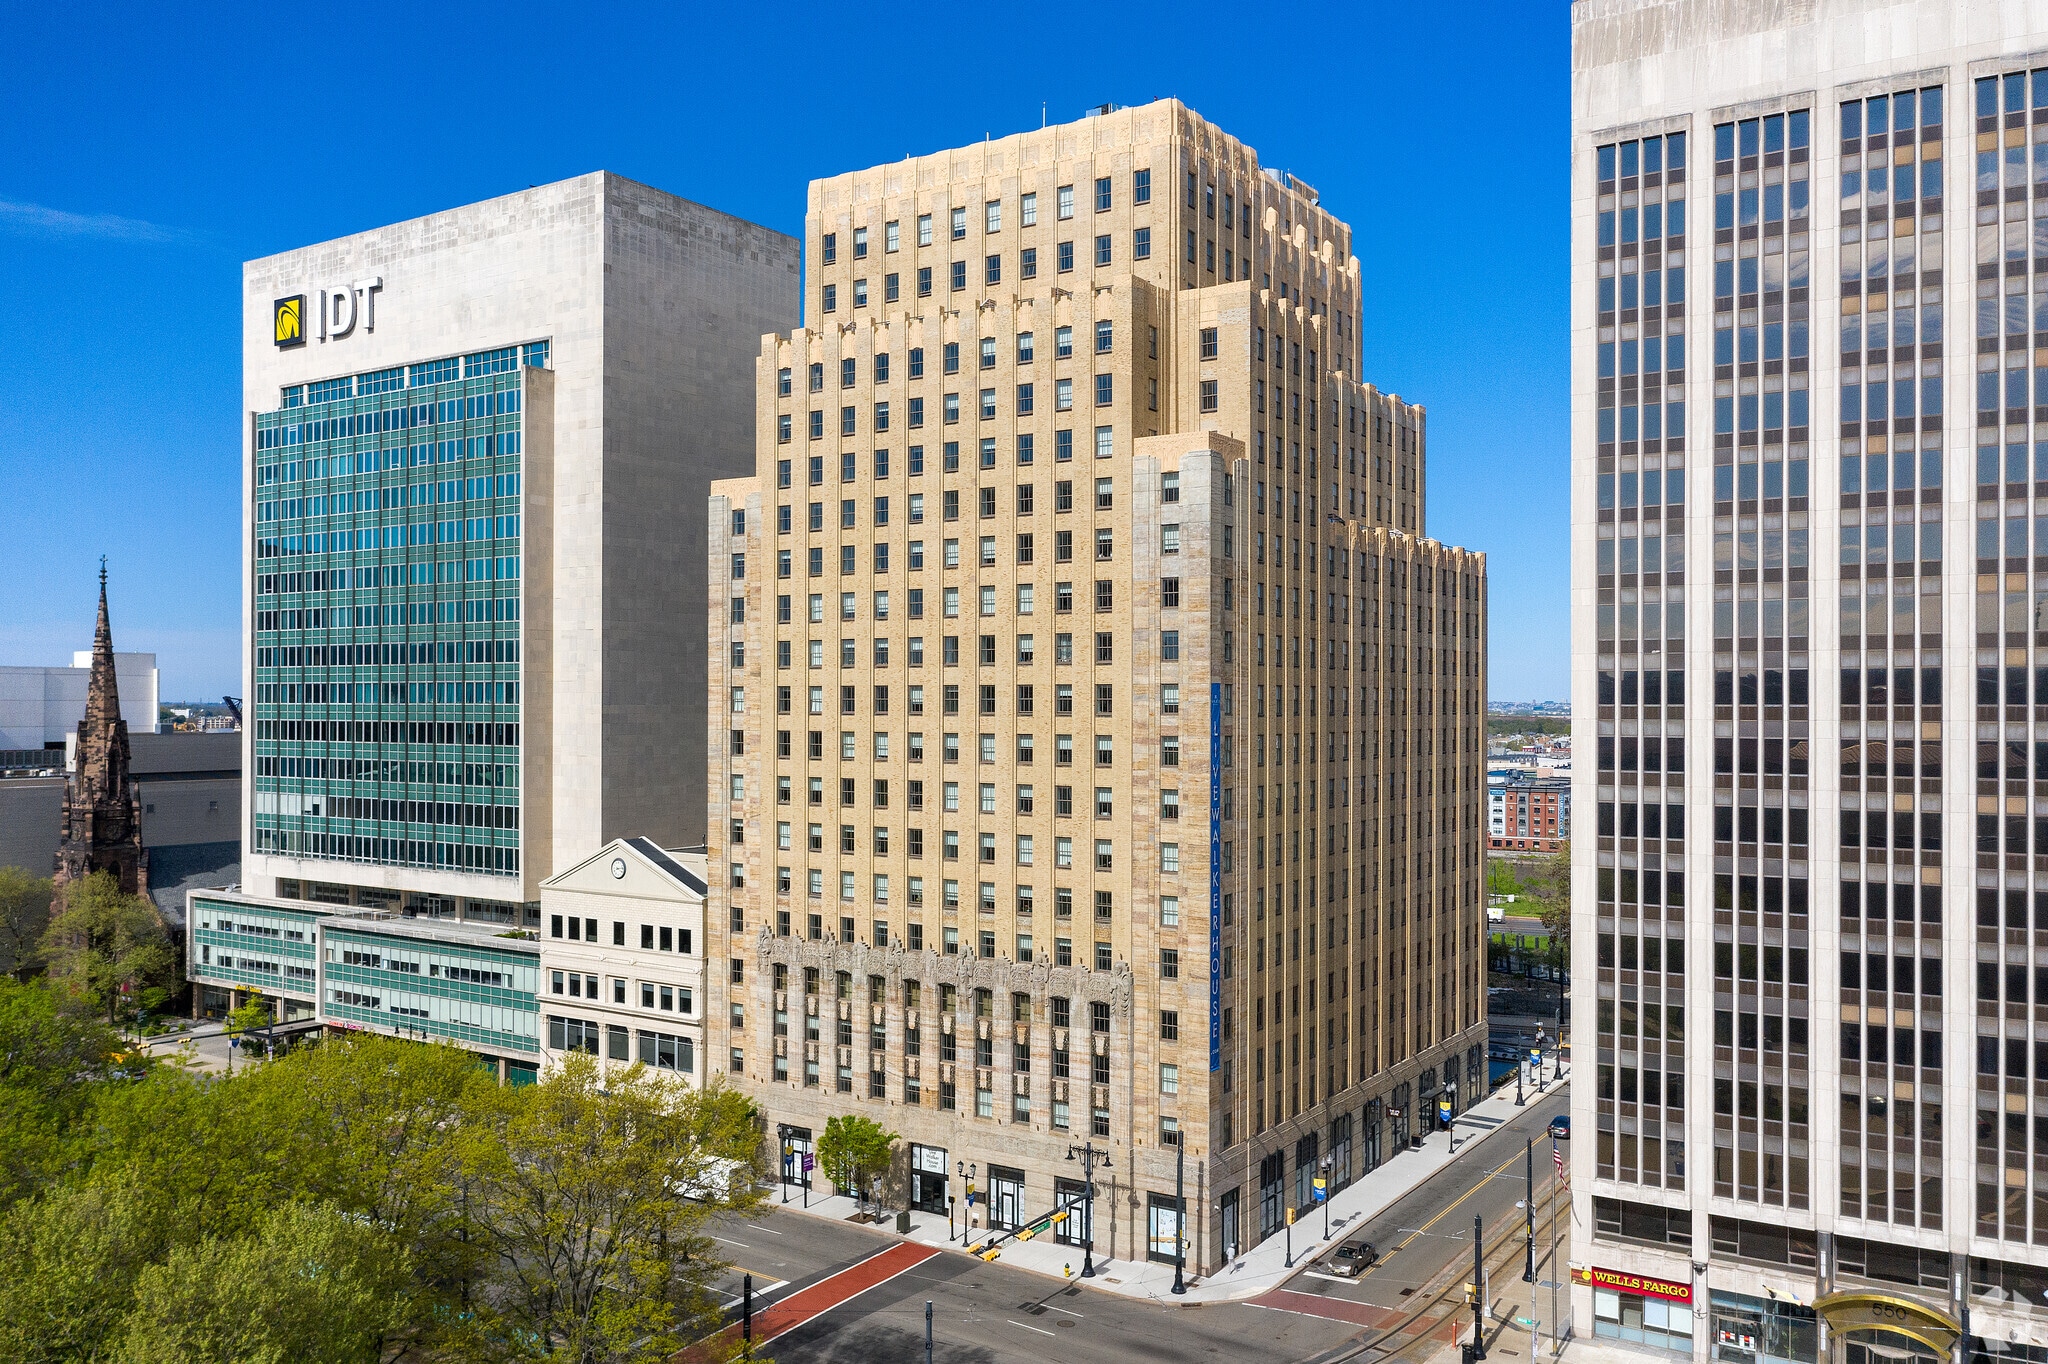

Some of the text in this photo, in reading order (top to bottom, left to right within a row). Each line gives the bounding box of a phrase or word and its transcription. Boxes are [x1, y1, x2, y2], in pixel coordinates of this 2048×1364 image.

[316, 276, 383, 338] IDT
[1594, 1271, 1689, 1298] WELLS FARGO
[1872, 1302, 1907, 1320] 550
